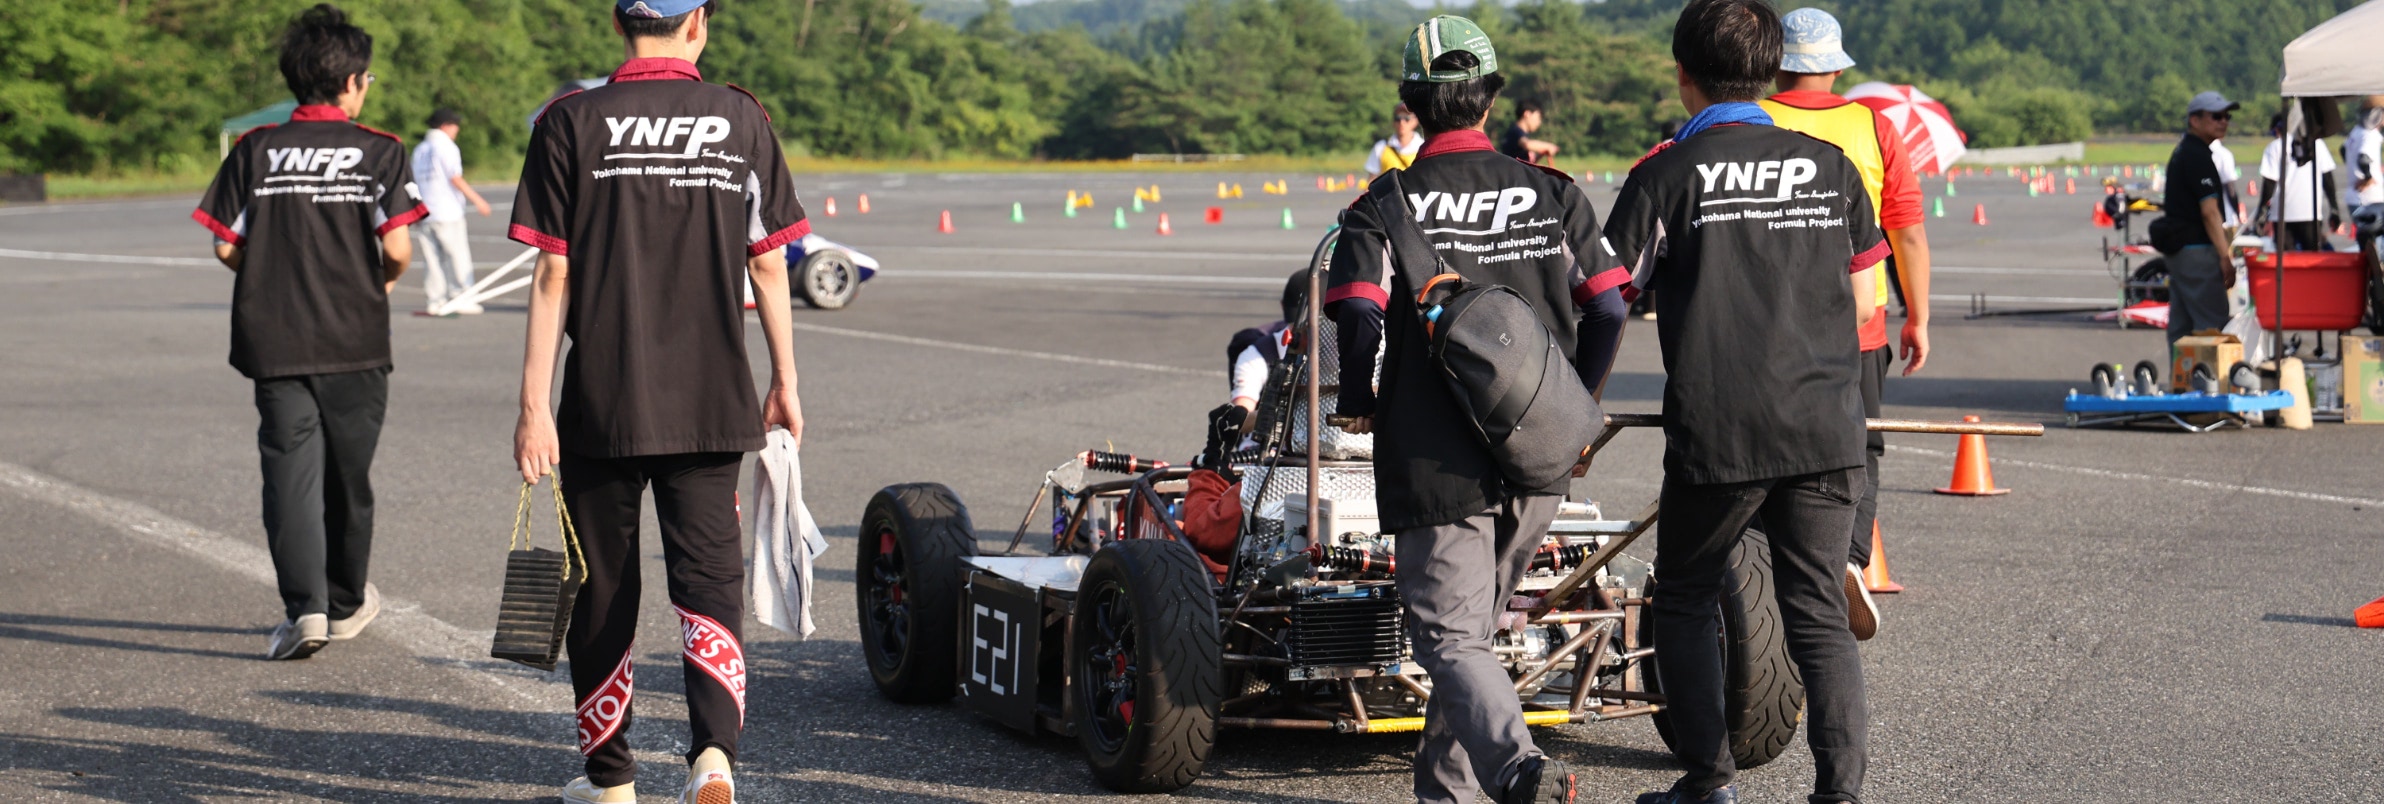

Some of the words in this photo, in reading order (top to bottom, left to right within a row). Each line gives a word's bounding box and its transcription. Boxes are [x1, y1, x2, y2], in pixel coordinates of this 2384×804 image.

[605, 116, 731, 159] YNFP
[266, 147, 364, 181] YNFP
[592, 166, 642, 179] Yokohama
[645, 165, 686, 175] National
[689, 165, 733, 179] university
[1695, 158, 1817, 200] YNFP
[669, 178, 707, 187] Formula
[709, 178, 742, 192] Project
[1408, 186, 1537, 231] YNFP
[1692, 211, 1741, 228] Yokohama
[1744, 208, 1782, 219] National
[1785, 206, 1831, 217] university
[1768, 219, 1806, 230] Formula
[1809, 217, 1843, 229] Project
[1454, 240, 1494, 252] National
[1497, 235, 1548, 250] university
[1478, 252, 1520, 264] Formula
[1523, 245, 1561, 260] Project
[682, 617, 728, 658] NE'S
[972, 603, 1021, 696] E21
[584, 695, 620, 731] TO
